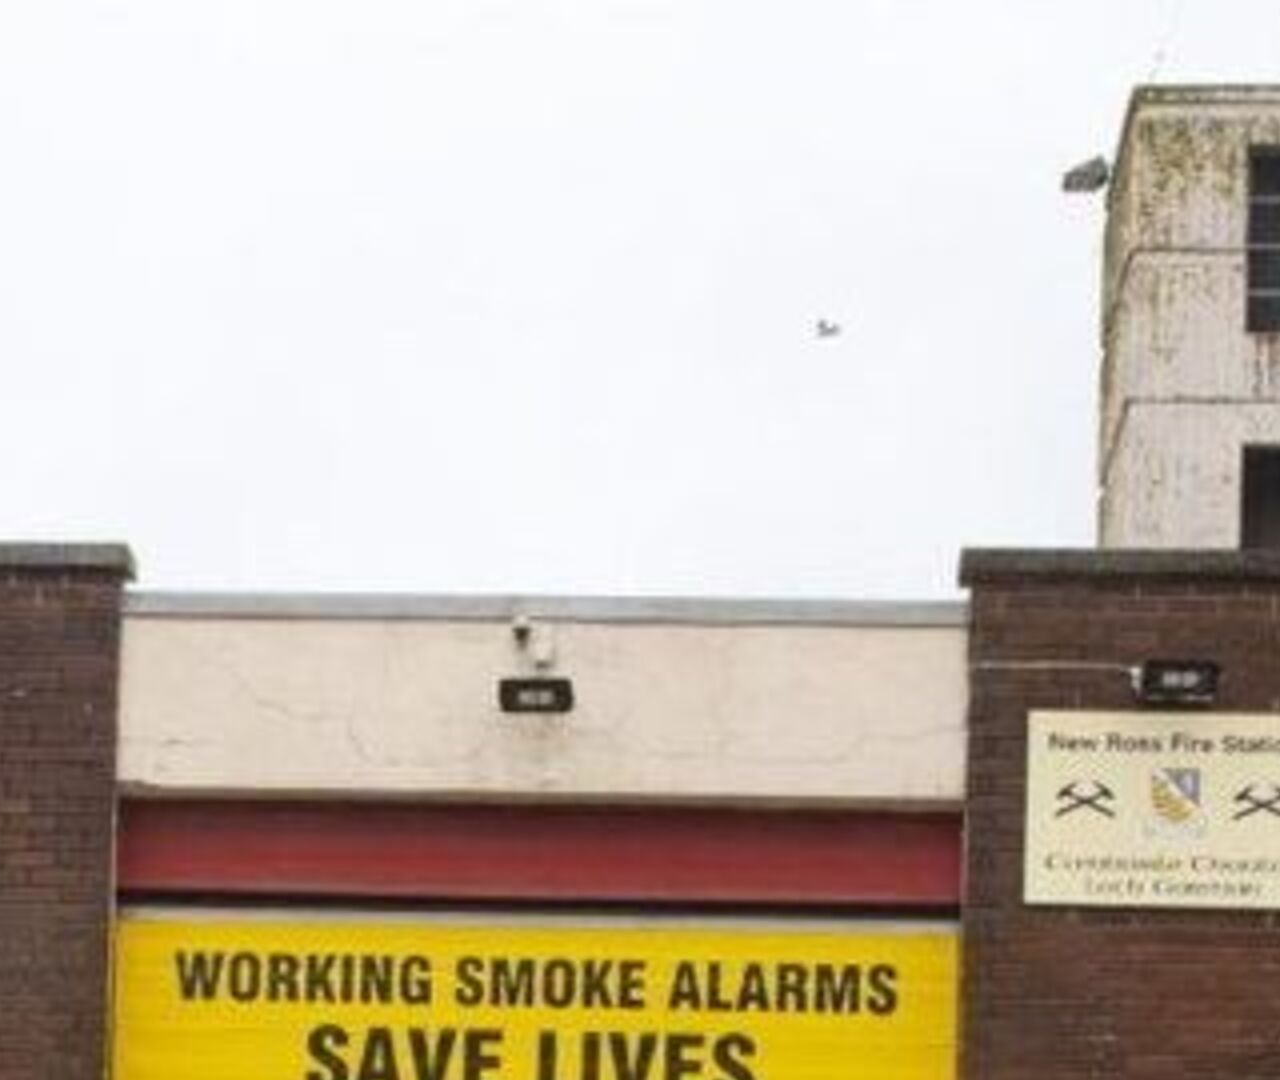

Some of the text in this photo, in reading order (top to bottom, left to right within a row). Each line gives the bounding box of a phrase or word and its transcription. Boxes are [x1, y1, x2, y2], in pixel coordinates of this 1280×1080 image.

[1047, 732, 1096, 751] New
[1105, 732, 1162, 752] Ross
[1171, 732, 1216, 753] Fire
[175, 950, 898, 1016] WORKING SMOKE ALARMS
